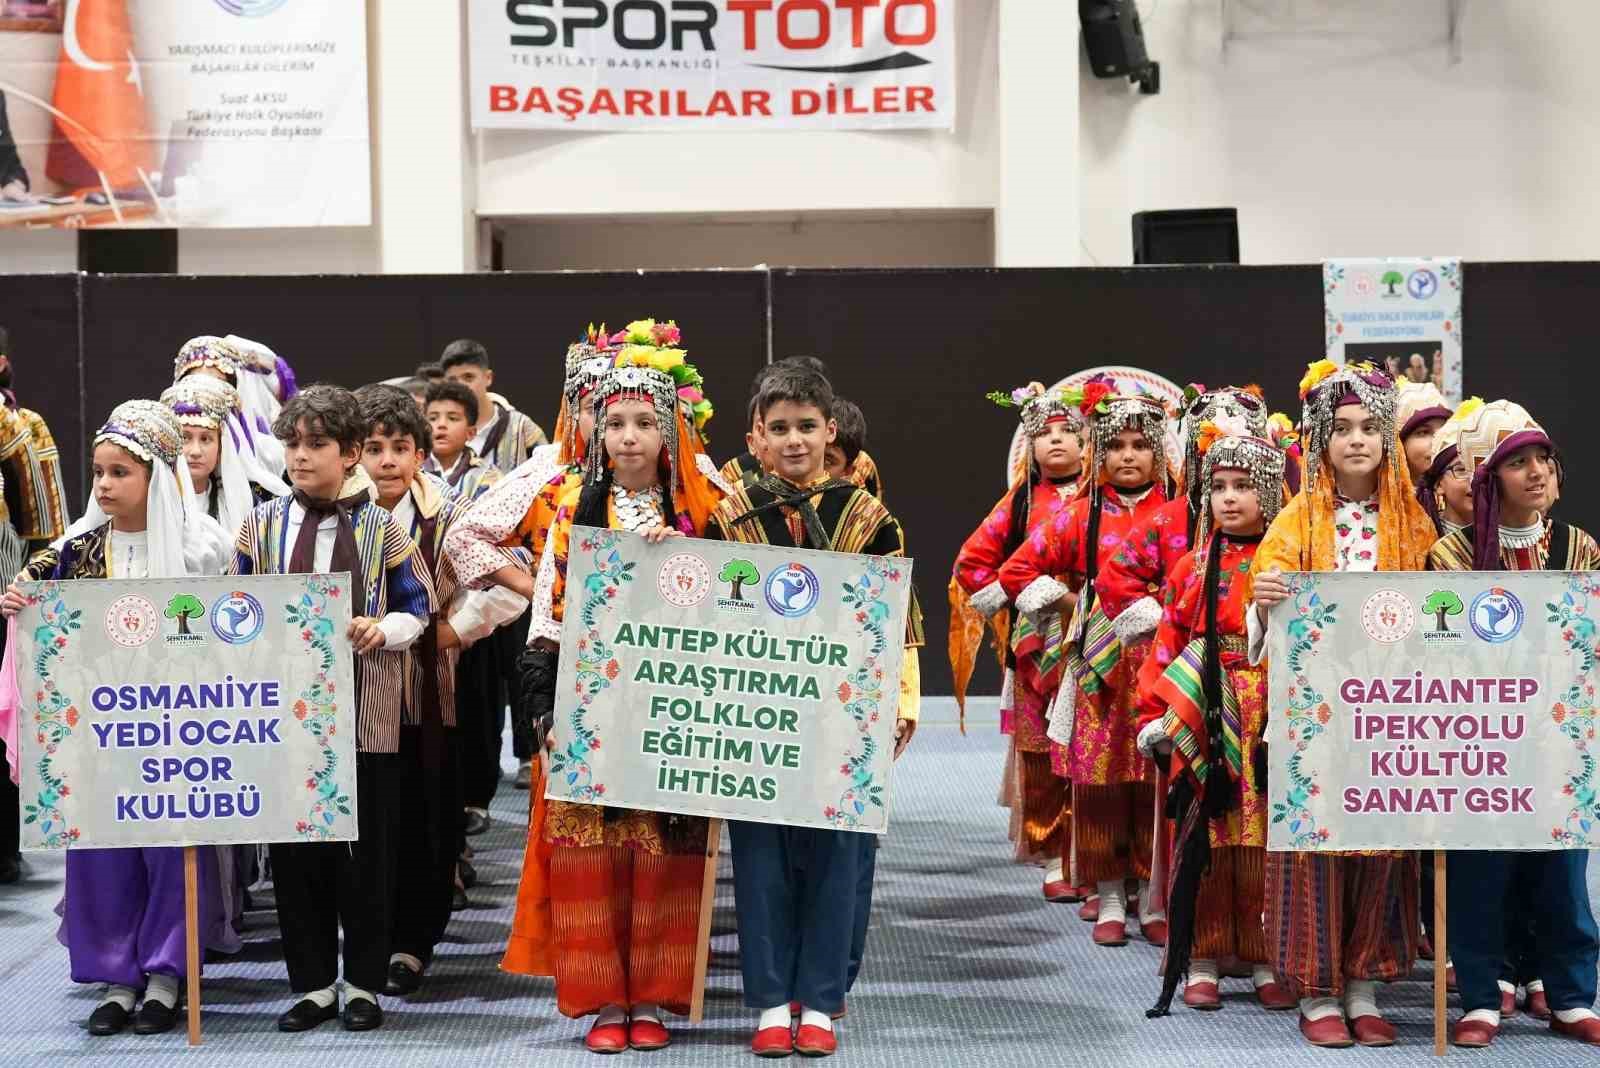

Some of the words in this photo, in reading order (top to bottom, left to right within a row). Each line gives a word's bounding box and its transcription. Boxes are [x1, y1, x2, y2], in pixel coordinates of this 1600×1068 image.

[511, 54, 597, 68] TEŞKİLAT
[606, 58, 720, 70] BAŞKANLIĞI
[490, 85, 773, 120] BAŞARILAR
[792, 82, 937, 115] DİLER
[614, 623, 718, 654] ANTEP
[725, 629, 848, 667] KÜLTÜR
[92, 676, 279, 712] OSMANİYE
[634, 659, 821, 699] ARAŞTIRMA
[1340, 670, 1538, 704] GAZİANTEP
[91, 714, 171, 748] YEDİ
[179, 719, 281, 746] OCAK
[650, 696, 798, 732] FOLKLOR
[1354, 707, 1524, 740] İPEKYOLU
[642, 726, 752, 764] EĞİTİM
[760, 742, 800, 768] VE
[1371, 744, 1507, 776] KÜLTÜR
[142, 757, 233, 784] SPOR
[658, 760, 777, 800] İHTİSAS
[116, 785, 260, 821] KULÜBÜ
[1344, 788, 1457, 813] SANAT
[1465, 788, 1533, 813] GSK
